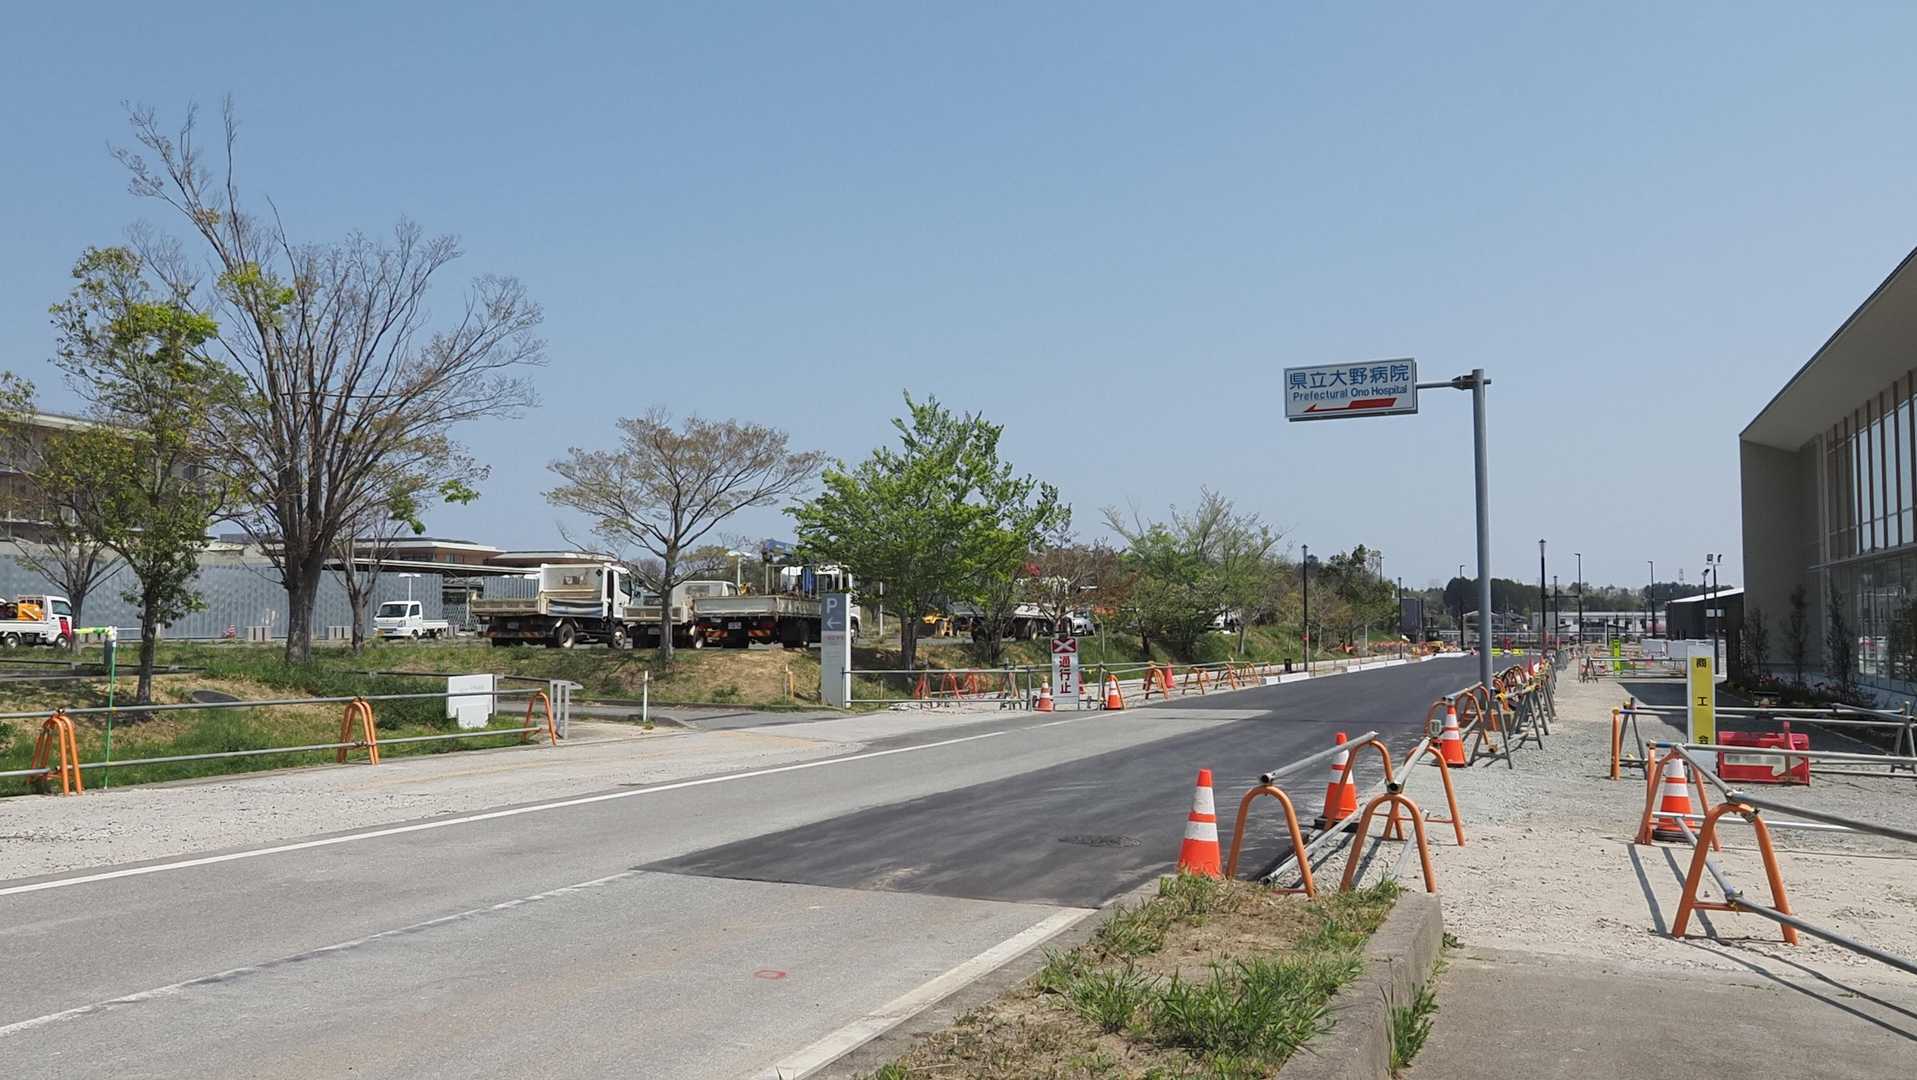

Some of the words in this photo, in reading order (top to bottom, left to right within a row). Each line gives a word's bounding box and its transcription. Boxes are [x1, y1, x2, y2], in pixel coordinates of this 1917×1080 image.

[1290, 365, 1409, 389] 県立大野病院
[1293, 388, 1348, 401] Prefectural
[1350, 387, 1370, 397] Ono
[1371, 384, 1408, 397] Hospital
[827, 598, 837, 613] P
[1059, 656, 1072, 693] 通行止
